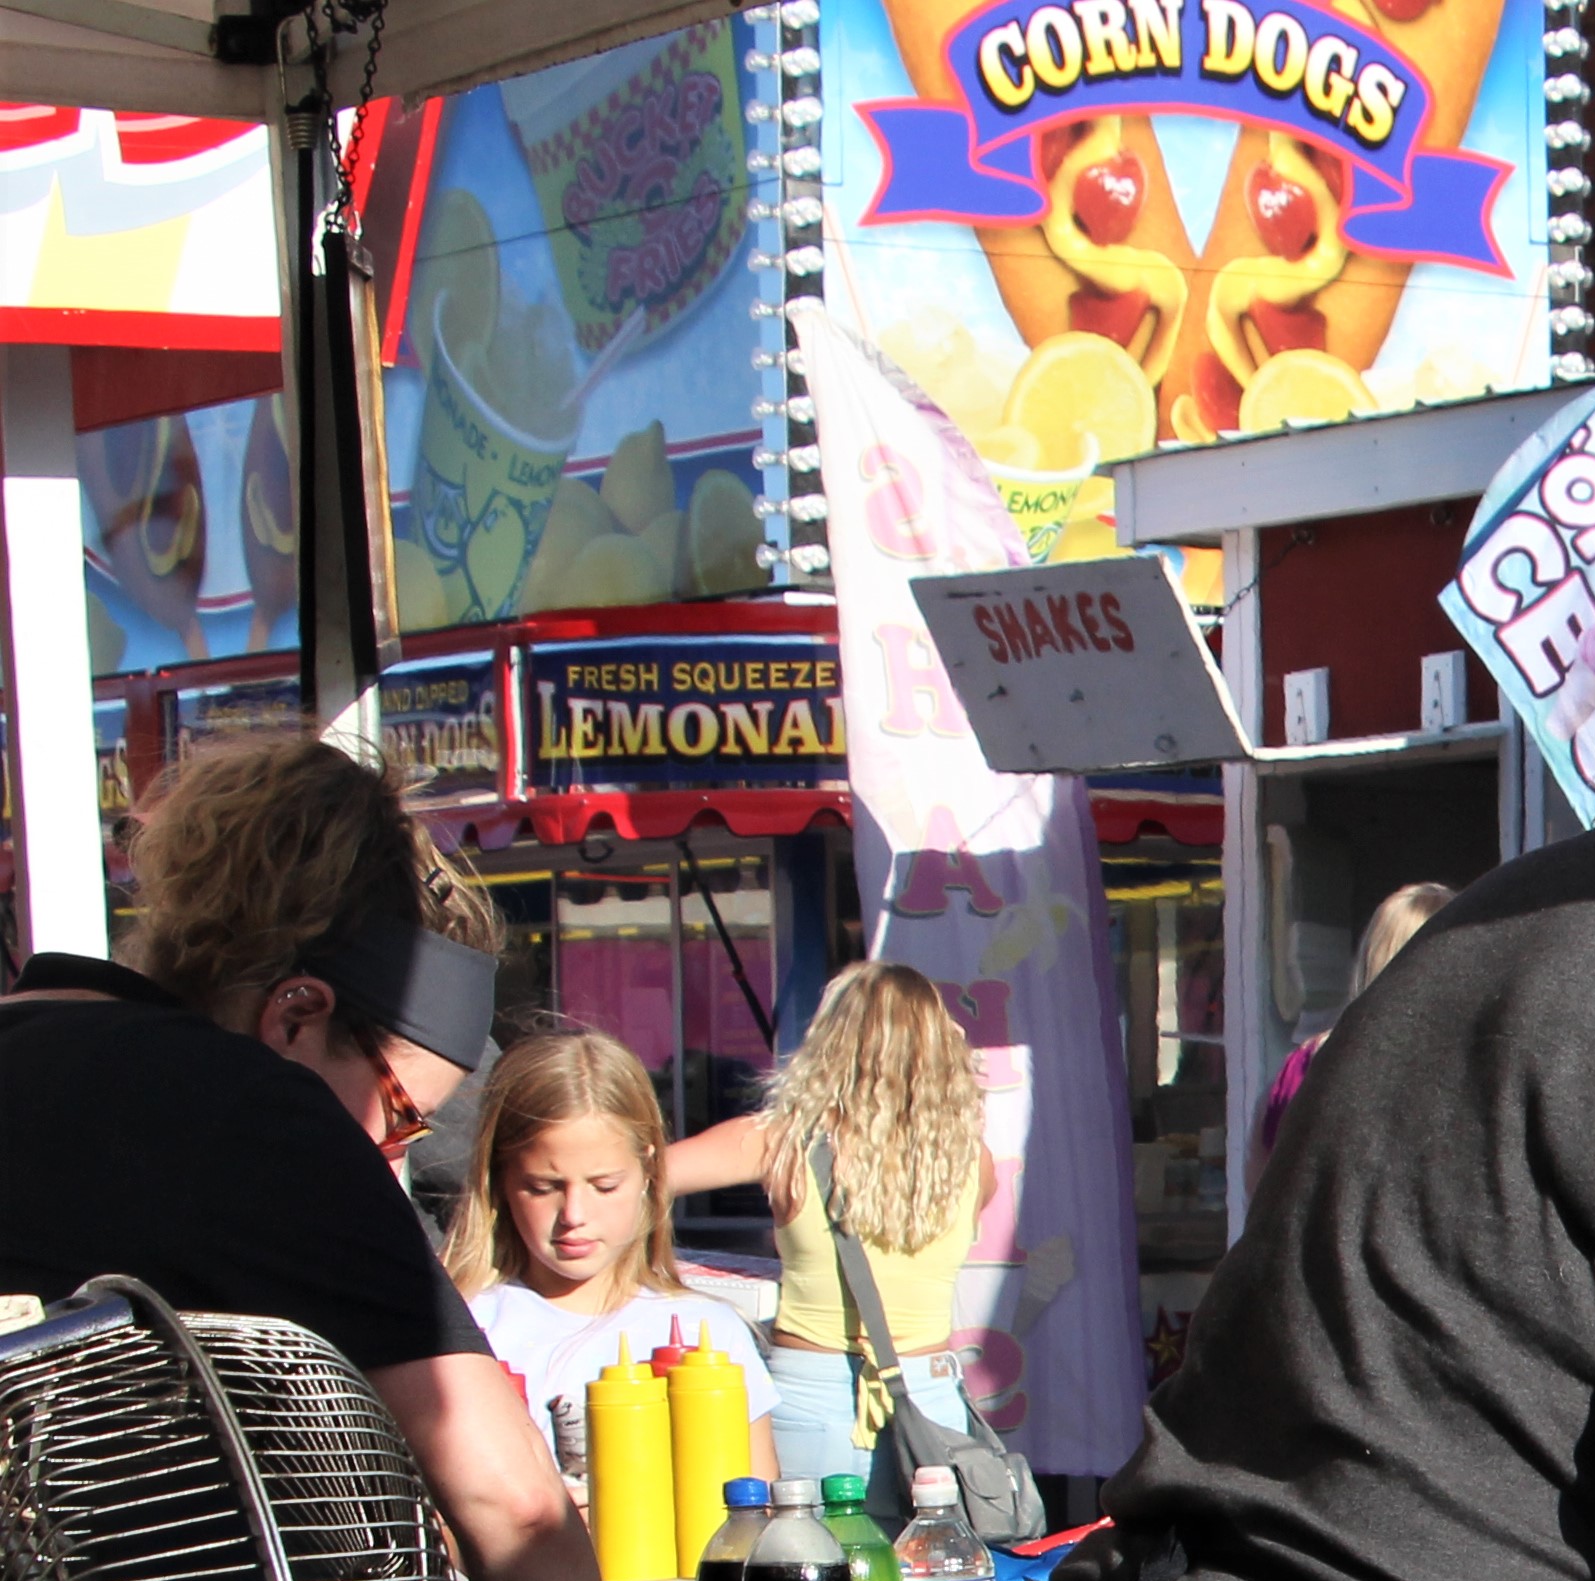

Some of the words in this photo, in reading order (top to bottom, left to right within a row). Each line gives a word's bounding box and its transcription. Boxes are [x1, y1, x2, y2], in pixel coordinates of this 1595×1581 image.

[979, 0, 1183, 106] CORN
[1201, 0, 1407, 143] DOGS
[562, 72, 722, 236] BUCKET
[606, 172, 722, 302] FRIES
[508, 454, 559, 487] LEMON
[973, 591, 1135, 663] SHAKES
[380, 688, 411, 713] AND
[415, 680, 469, 709] DIPPED
[567, 663, 659, 692] FRESH
[672, 660, 837, 695] SQUEEZE
[537, 680, 847, 760] LEMONA
